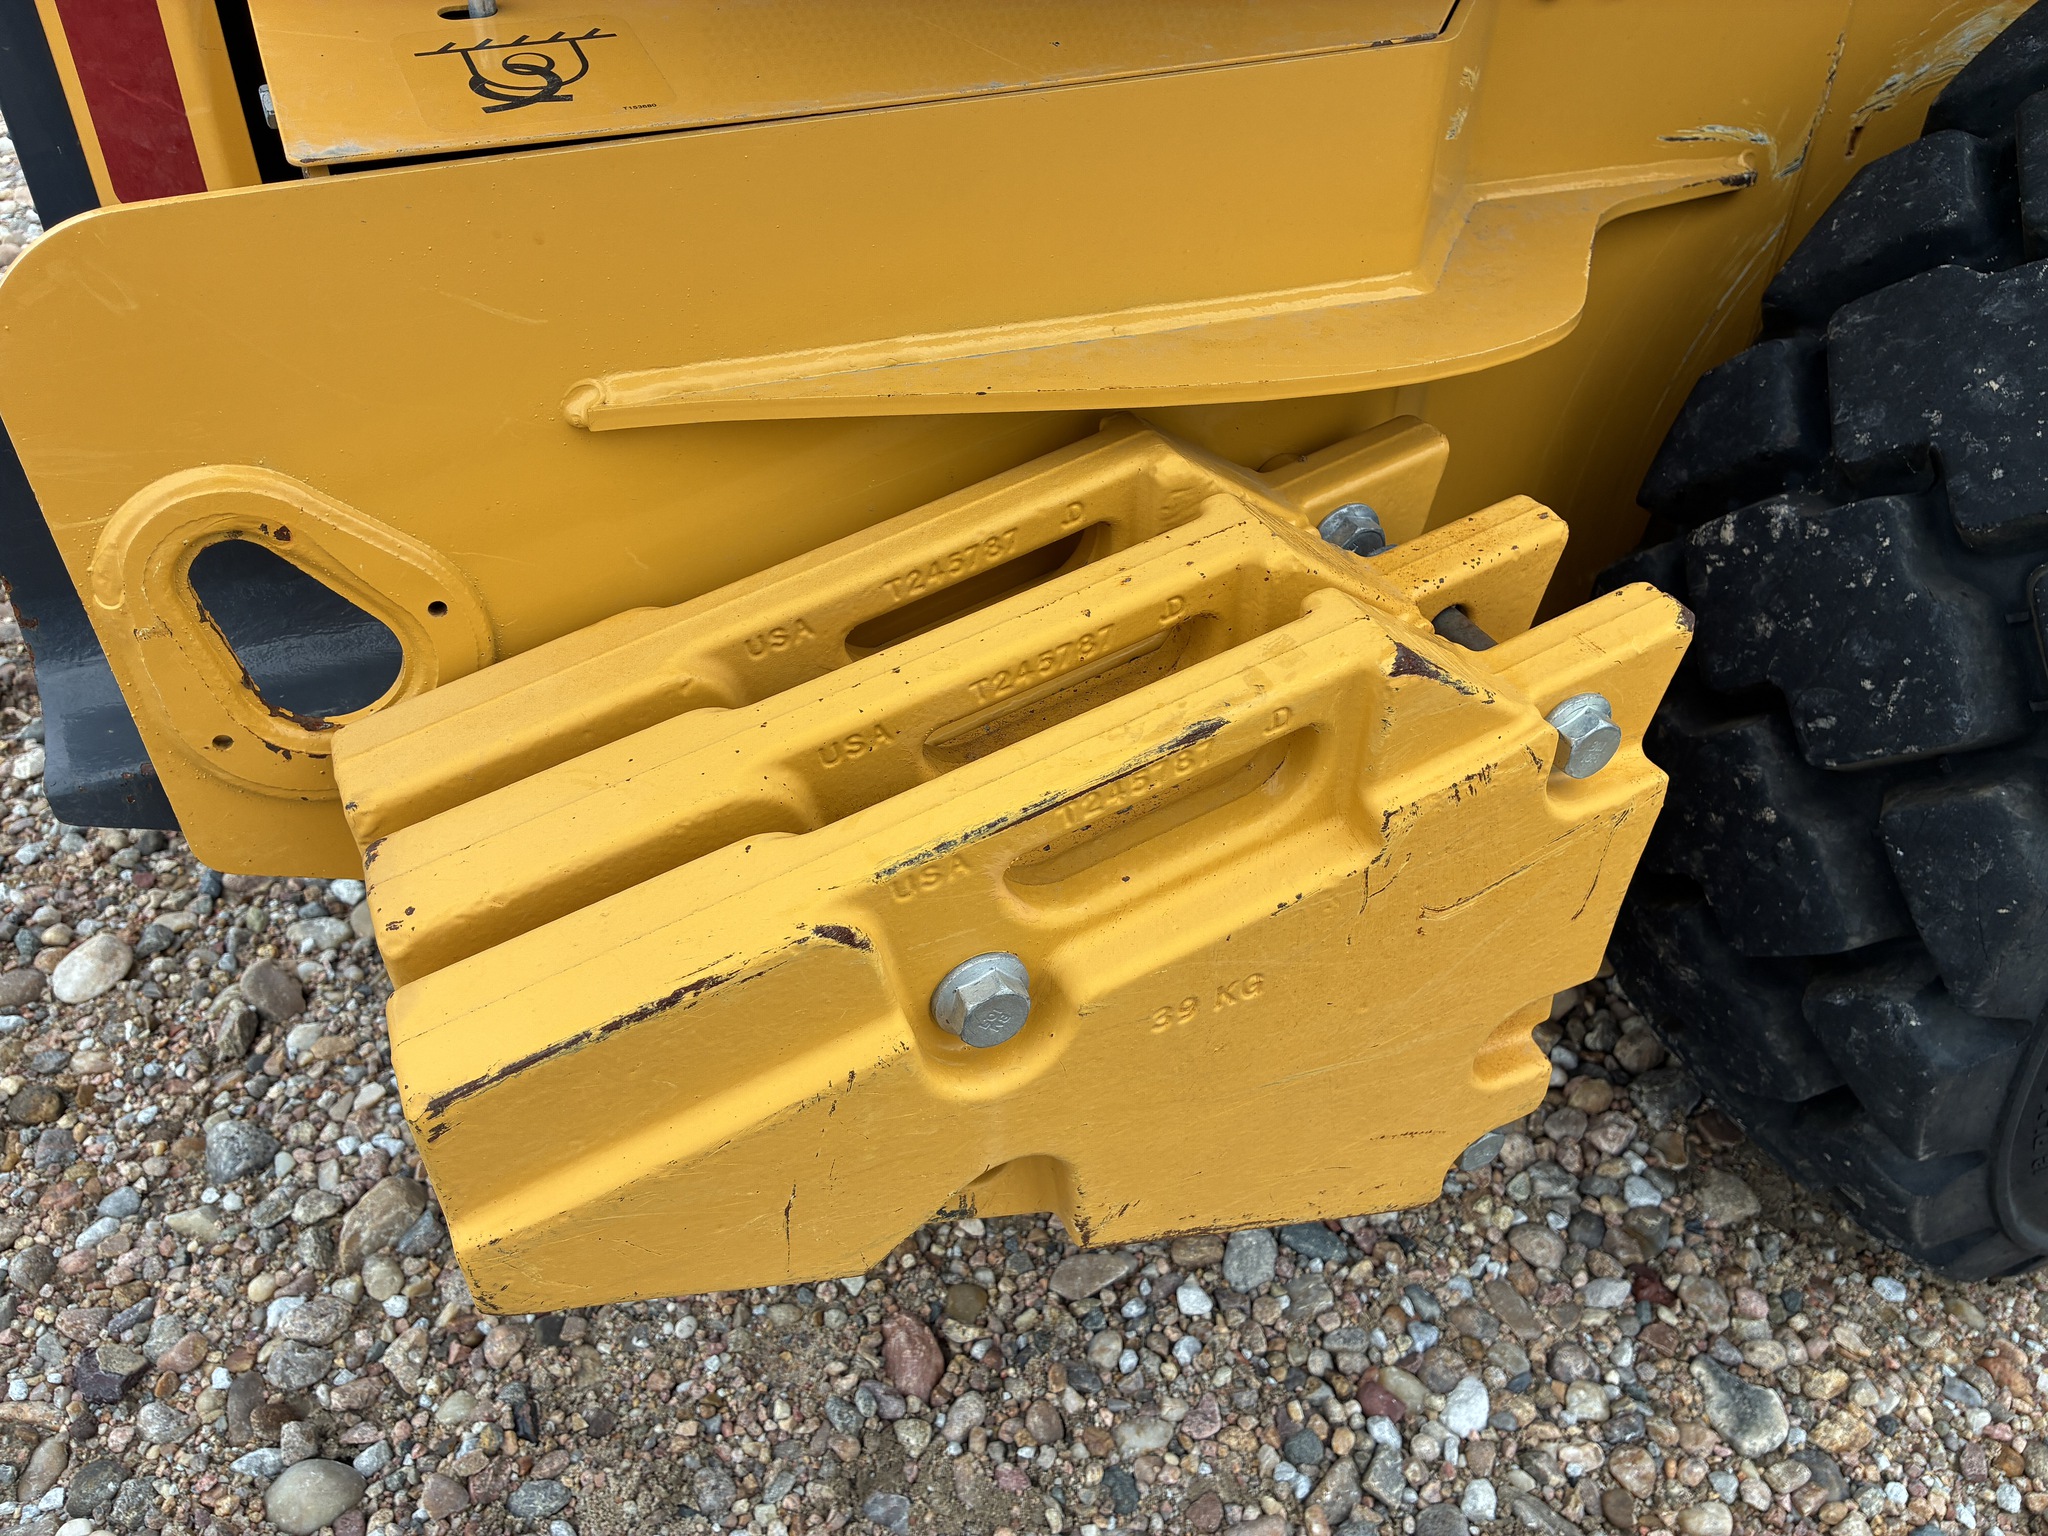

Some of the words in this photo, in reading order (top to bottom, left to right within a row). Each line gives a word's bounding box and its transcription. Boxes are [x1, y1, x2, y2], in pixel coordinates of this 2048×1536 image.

[743, 618, 816, 660] USA
[881, 527, 1018, 601] T245787
[817, 723, 895, 768] USA
[968, 622, 1115, 704] T245787
[888, 853, 971, 902] USA
[1150, 996, 1199, 1033] 39
[1213, 972, 1264, 1012] KG
